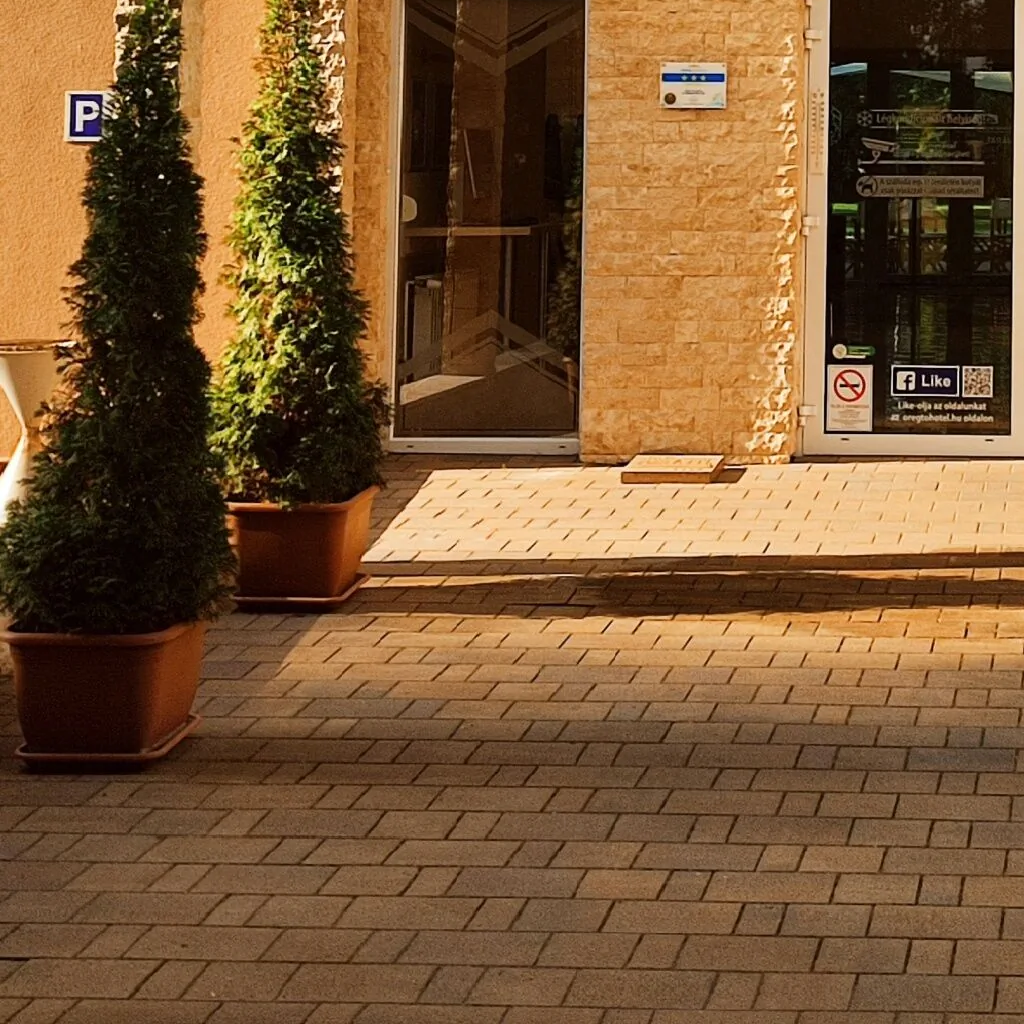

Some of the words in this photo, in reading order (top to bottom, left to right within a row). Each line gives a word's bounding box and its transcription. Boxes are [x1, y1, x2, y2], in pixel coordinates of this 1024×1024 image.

[74, 100, 100, 132] P
[921, 374, 951, 388] Like
[898, 401, 932, 411] Like-olja
[933, 402, 943, 410] az
[944, 401, 987, 411] oldalunkat
